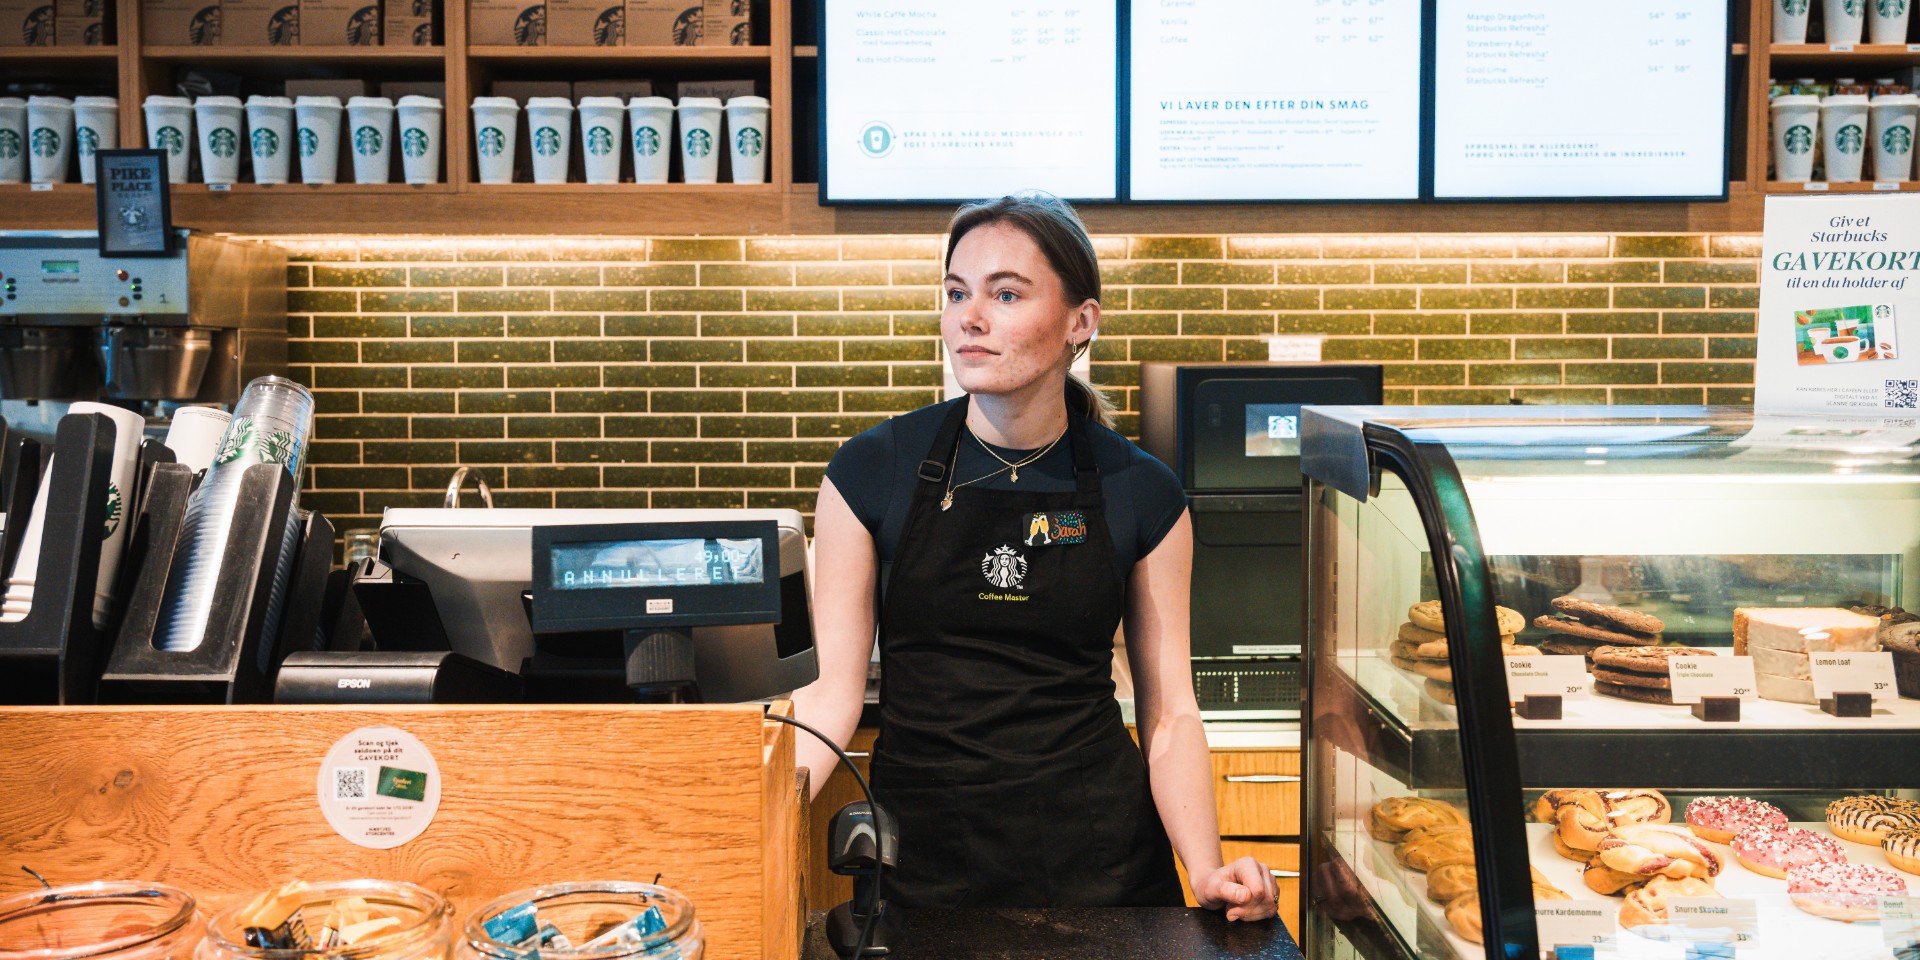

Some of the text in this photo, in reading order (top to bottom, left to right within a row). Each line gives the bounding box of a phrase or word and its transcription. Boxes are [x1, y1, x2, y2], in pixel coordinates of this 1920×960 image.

[856, 10, 881, 18] White
[908, 10, 936, 18] Mocha
[1466, 12, 1495, 21] Mango
[1466, 24, 1507, 32] Starbucks
[1466, 40, 1512, 48] Strawberry
[1466, 50, 1506, 58] Starbucks
[1466, 76, 1506, 84] Starbucks
[1160, 100, 1369, 110] VI LAVER DEN EFTER DIN SMAG
[110, 168, 151, 180] PIKE
[112, 182, 152, 192] PLACE
[1830, 216, 1870, 228] Giv et
[1810, 230, 1888, 242] Starbucks
[1773, 252, 1920, 271] GAVEKORT
[1786, 276, 1908, 290] til en du holder af
[564, 566, 739, 585] ANNULLERET
[978, 592, 1030, 602] Coffee Master
[338, 679, 370, 688] EPSON
[1884, 900, 1904, 908] Donut
[1556, 908, 1602, 916] Kardemomme
[1674, 906, 1728, 914] Snurre Skovbær
